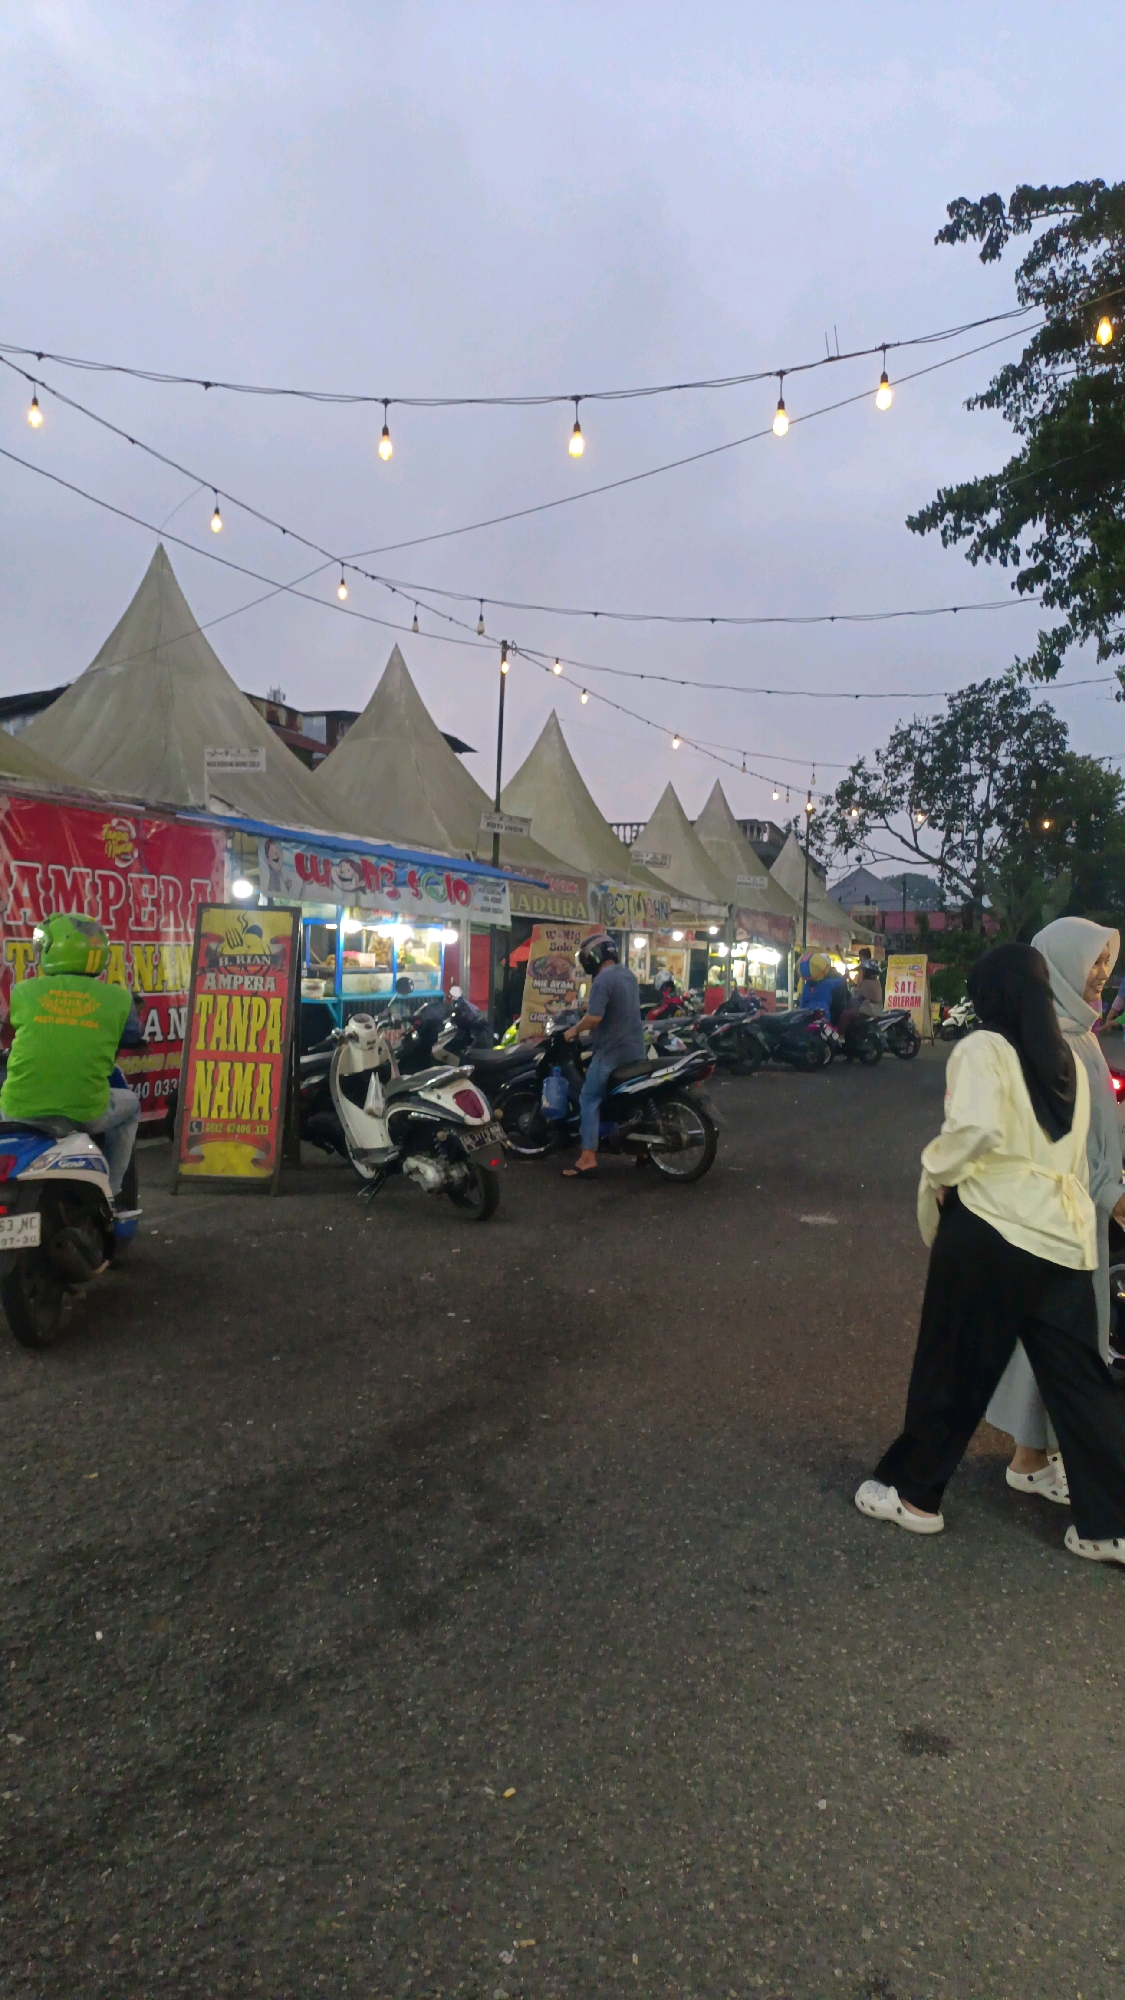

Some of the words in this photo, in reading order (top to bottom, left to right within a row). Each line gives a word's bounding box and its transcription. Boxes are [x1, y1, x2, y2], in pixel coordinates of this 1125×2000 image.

[3, 859, 212, 932] AMPERA
[236, 955, 271, 965] RIAN
[203, 972, 277, 992] AMPERA
[894, 981, 917, 993] SATE
[887, 995, 921, 1008] SOLERAM
[195, 993, 283, 1054] TANPA
[190, 1060, 273, 1121] NAMA
